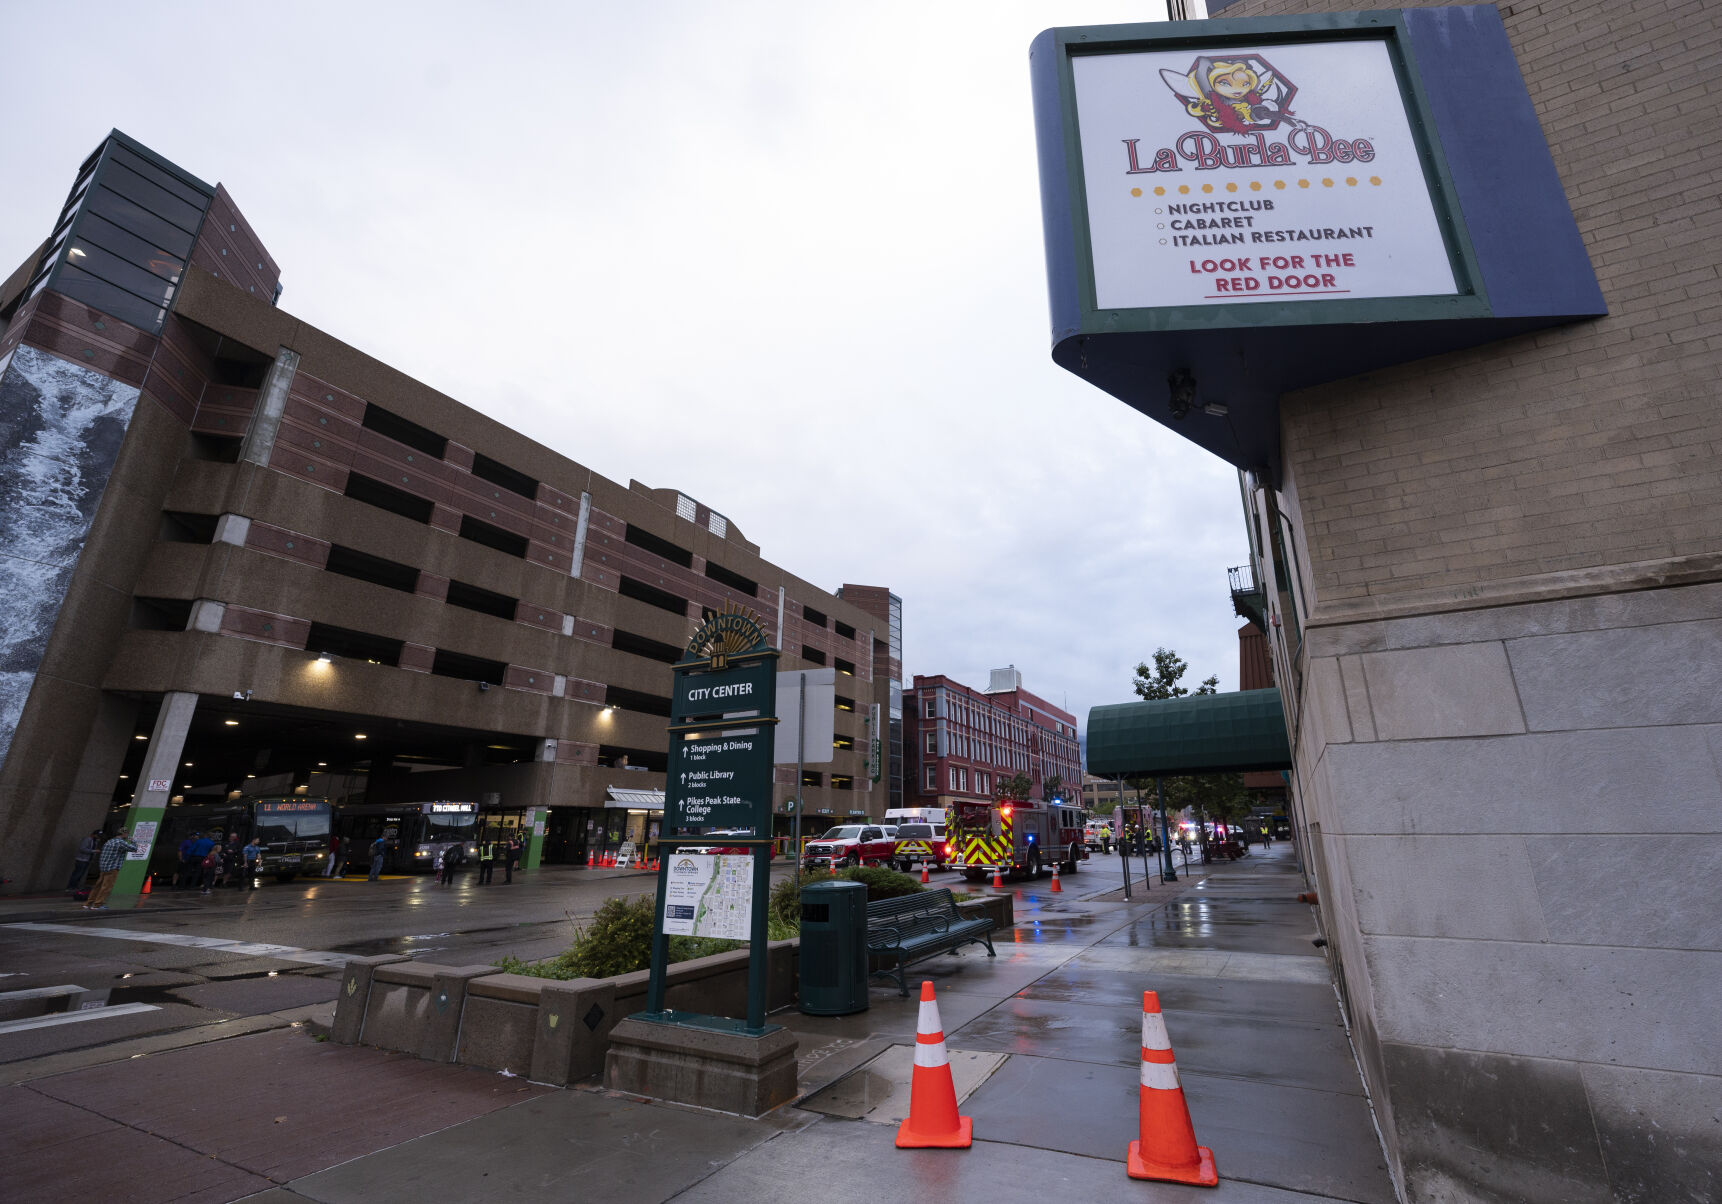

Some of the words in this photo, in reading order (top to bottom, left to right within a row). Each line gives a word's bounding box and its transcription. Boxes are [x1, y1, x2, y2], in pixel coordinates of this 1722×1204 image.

[1168, 199, 1275, 216] NIGHTCLUB
[1170, 216, 1254, 231] CABARET
[1172, 232, 1245, 247] ITALIAN
[1250, 226, 1374, 244] RESTAURANT
[1190, 257, 1252, 275] LOOK
[1260, 255, 1305, 271] FOR
[1310, 252, 1356, 269] THE
[1215, 276, 1260, 292] RED
[1268, 273, 1337, 290] DOOR
[688, 616, 761, 654] DOWNTOWN
[688, 686, 710, 701] CITY
[712, 682, 753, 698] CENTER
[690, 743, 722, 753] Shopping
[723, 742, 729, 750] &
[730, 741, 753, 751] Dining
[688, 772, 709, 780] Public
[710, 770, 734, 780] Library
[686, 804, 712, 814] College
[687, 798, 704, 806] Pikes
[705, 797, 722, 805] Peak
[722, 796, 741, 804] State
[788, 802, 794, 811] P
